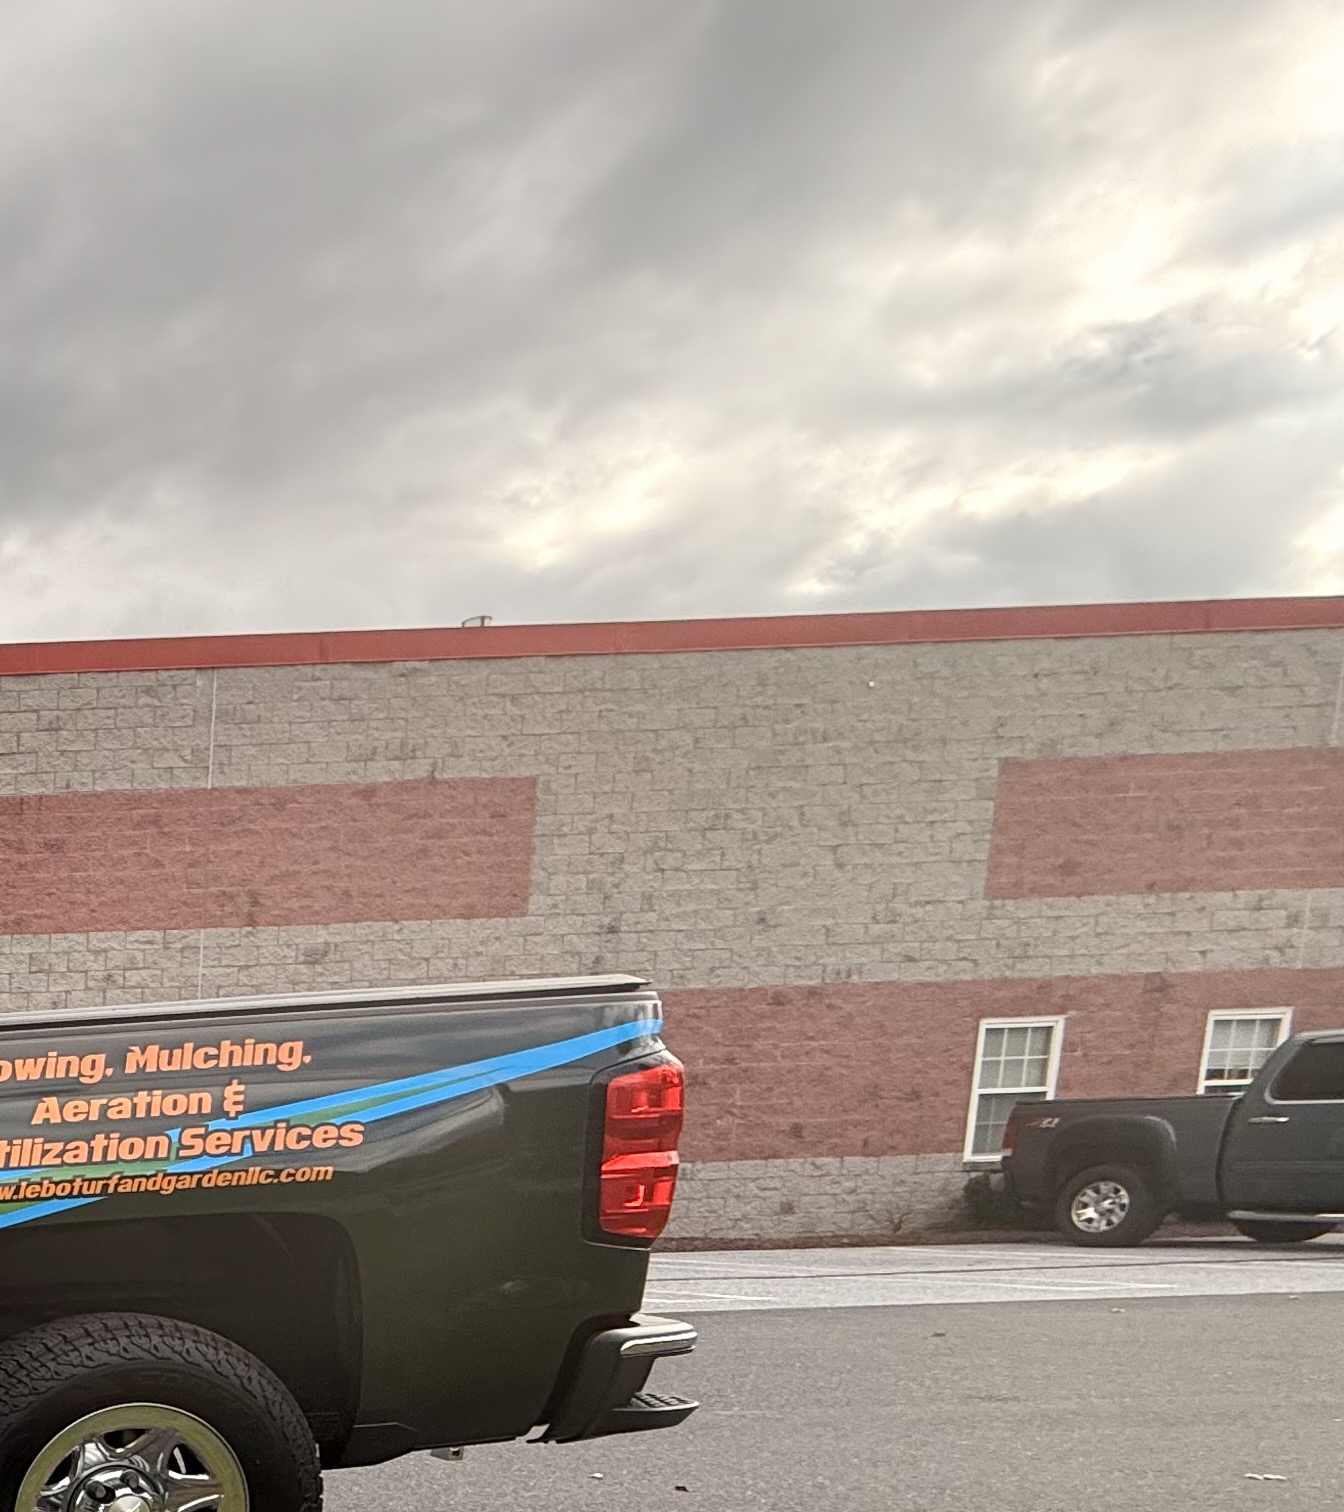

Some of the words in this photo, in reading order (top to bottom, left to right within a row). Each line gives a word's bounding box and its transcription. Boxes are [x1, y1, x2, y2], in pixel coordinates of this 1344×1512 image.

[124, 1038, 313, 1075] Mulching,
[30, 1090, 213, 1125] Aeration
[223, 1079, 246, 1118] &
[179, 1121, 365, 1157] Services
